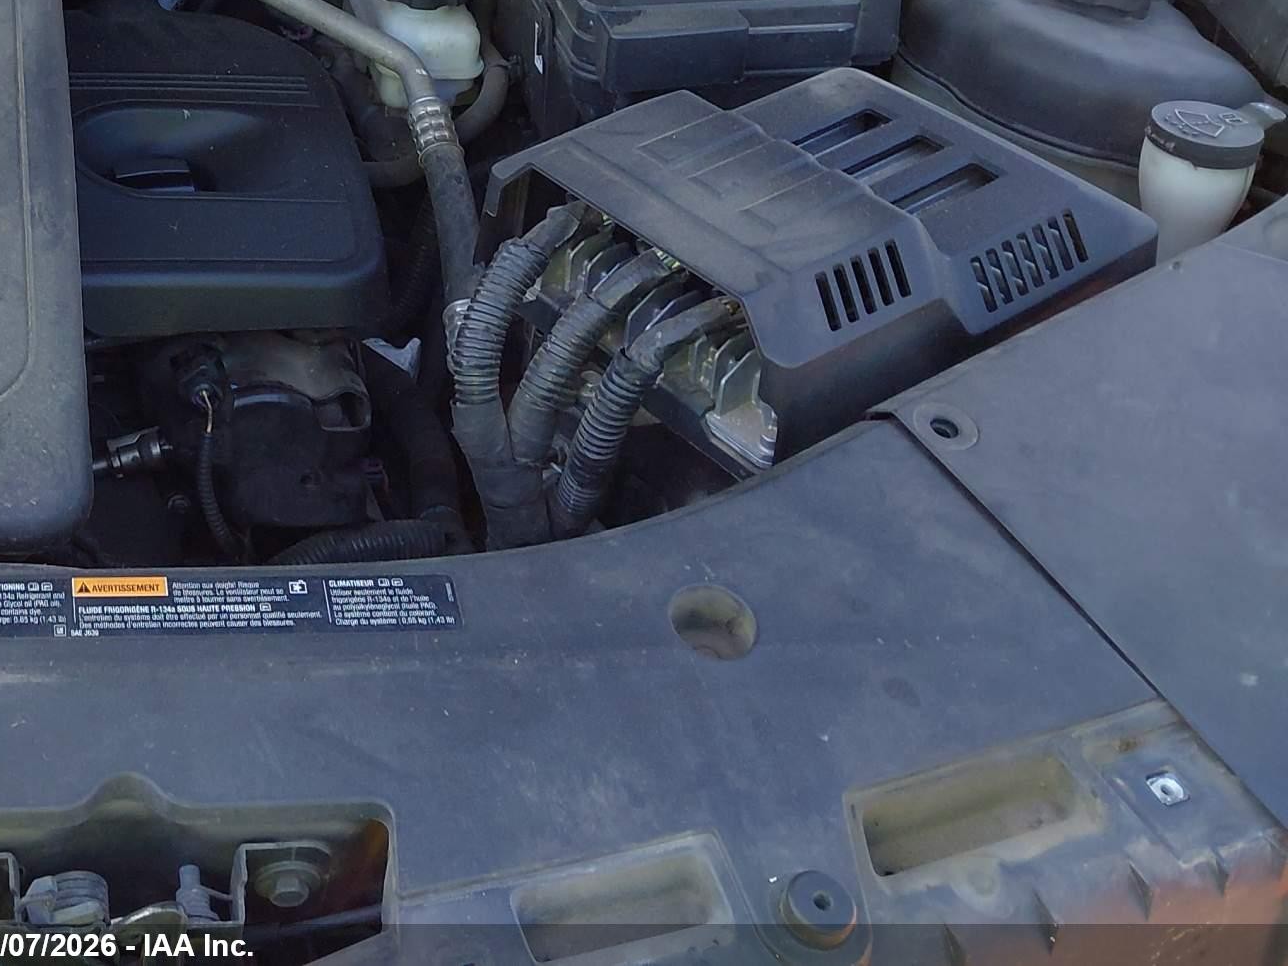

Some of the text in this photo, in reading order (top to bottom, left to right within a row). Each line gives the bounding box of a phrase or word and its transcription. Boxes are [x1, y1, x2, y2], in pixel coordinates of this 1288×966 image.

[172, 581, 201, 589] Attention
[328, 579, 374, 587] CLIMATISEUR
[91, 583, 160, 593] AVERTISSEMENT
[0, 608, 28, 616] contains
[78, 606, 103, 614] FLUIDE
[150, 605, 176, 613] R-134a
[176, 605, 196, 613] SOUS
[196, 605, 220, 613] HAUTE
[220, 604, 256, 612] PRESSION
